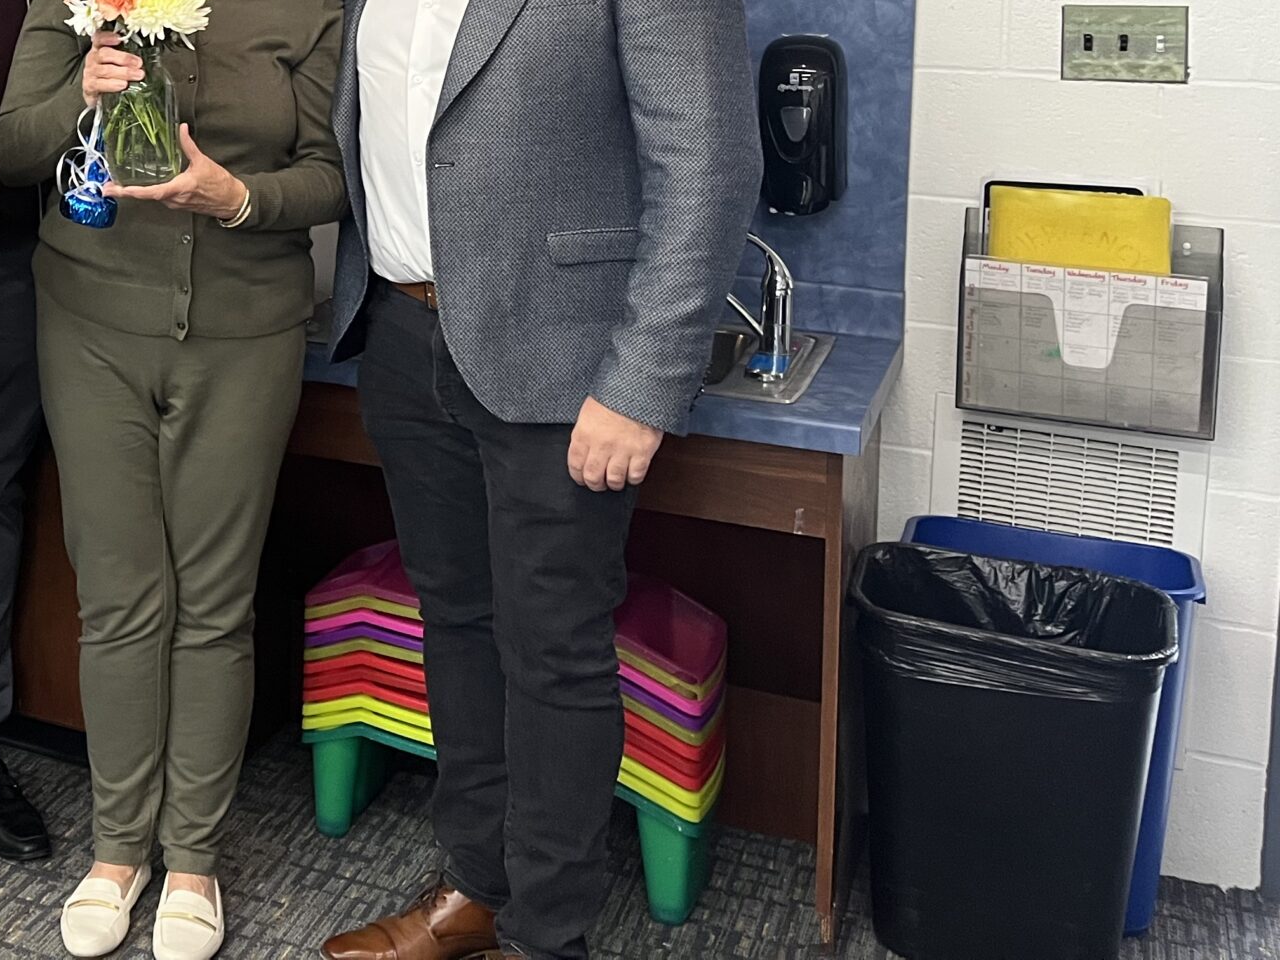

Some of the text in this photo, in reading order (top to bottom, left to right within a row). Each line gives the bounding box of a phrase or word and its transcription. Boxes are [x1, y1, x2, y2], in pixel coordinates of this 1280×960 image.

[982, 263, 1010, 273] Monday
[1025, 265, 1056, 277] Tuesday
[1066, 270, 1106, 282] Wednesday
[1112, 274, 1147, 286] Thursday
[1160, 279, 1189, 290] Friday
